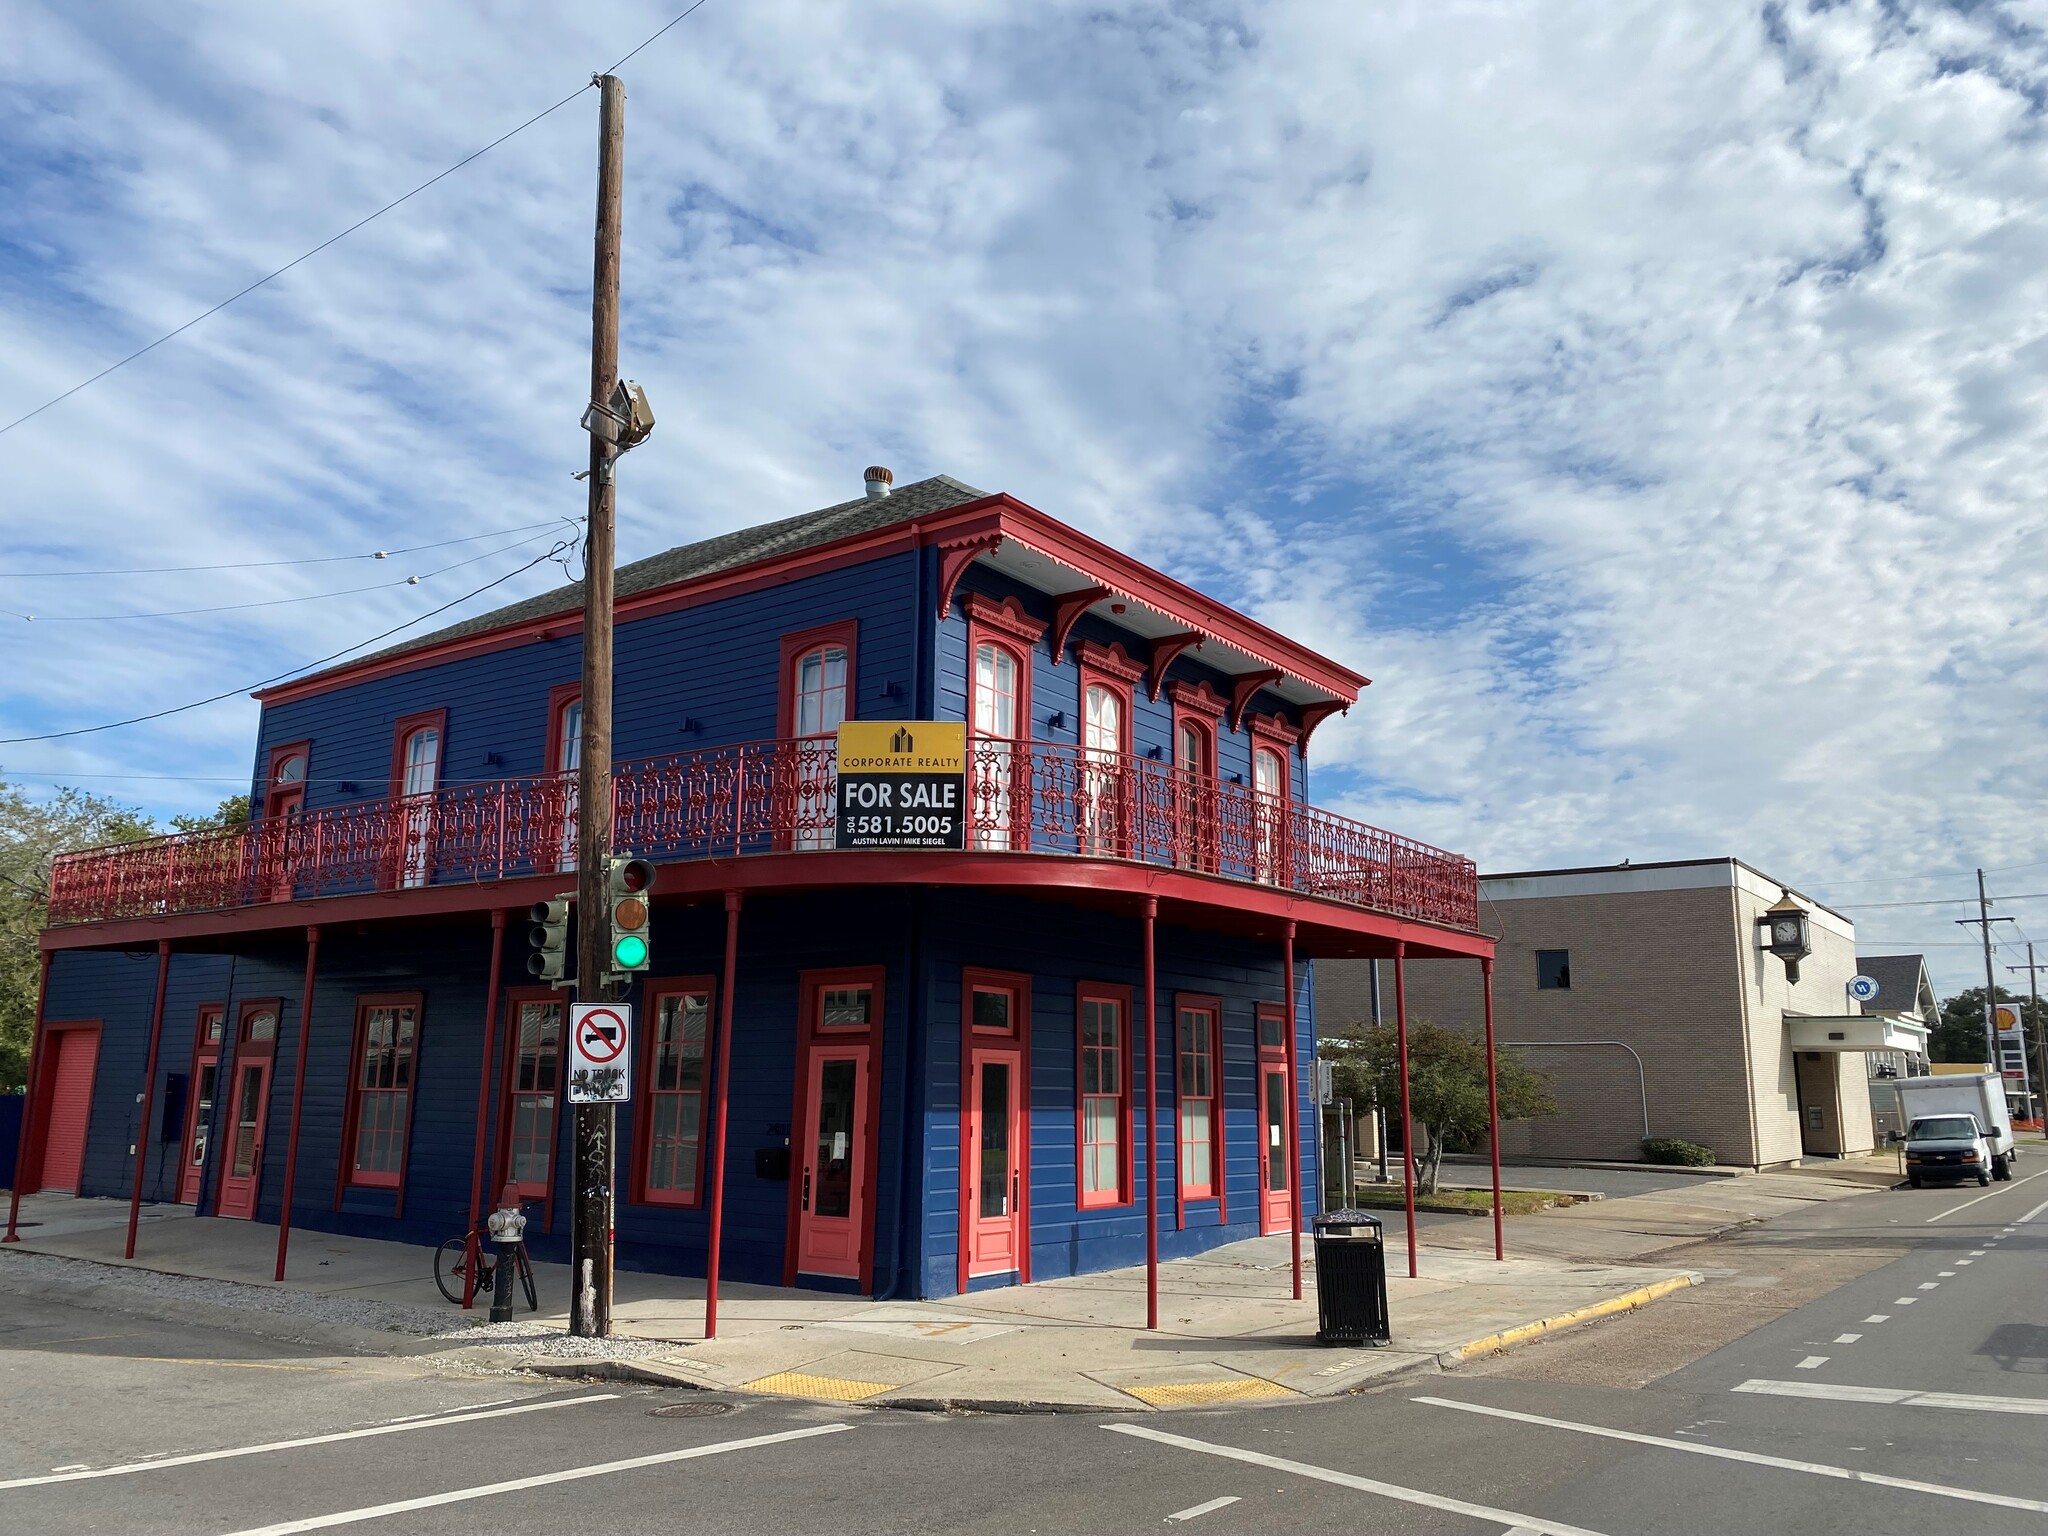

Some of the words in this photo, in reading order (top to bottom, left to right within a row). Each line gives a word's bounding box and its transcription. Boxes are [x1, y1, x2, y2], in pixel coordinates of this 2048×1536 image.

[843, 757, 912, 767] CORPORATE
[918, 757, 960, 767] REALTY
[845, 782, 892, 808] FOR
[899, 782, 955, 808] SALE
[847, 816, 856, 833] 504
[857, 815, 952, 834] 581.5005
[574, 1069, 589, 1080] NO
